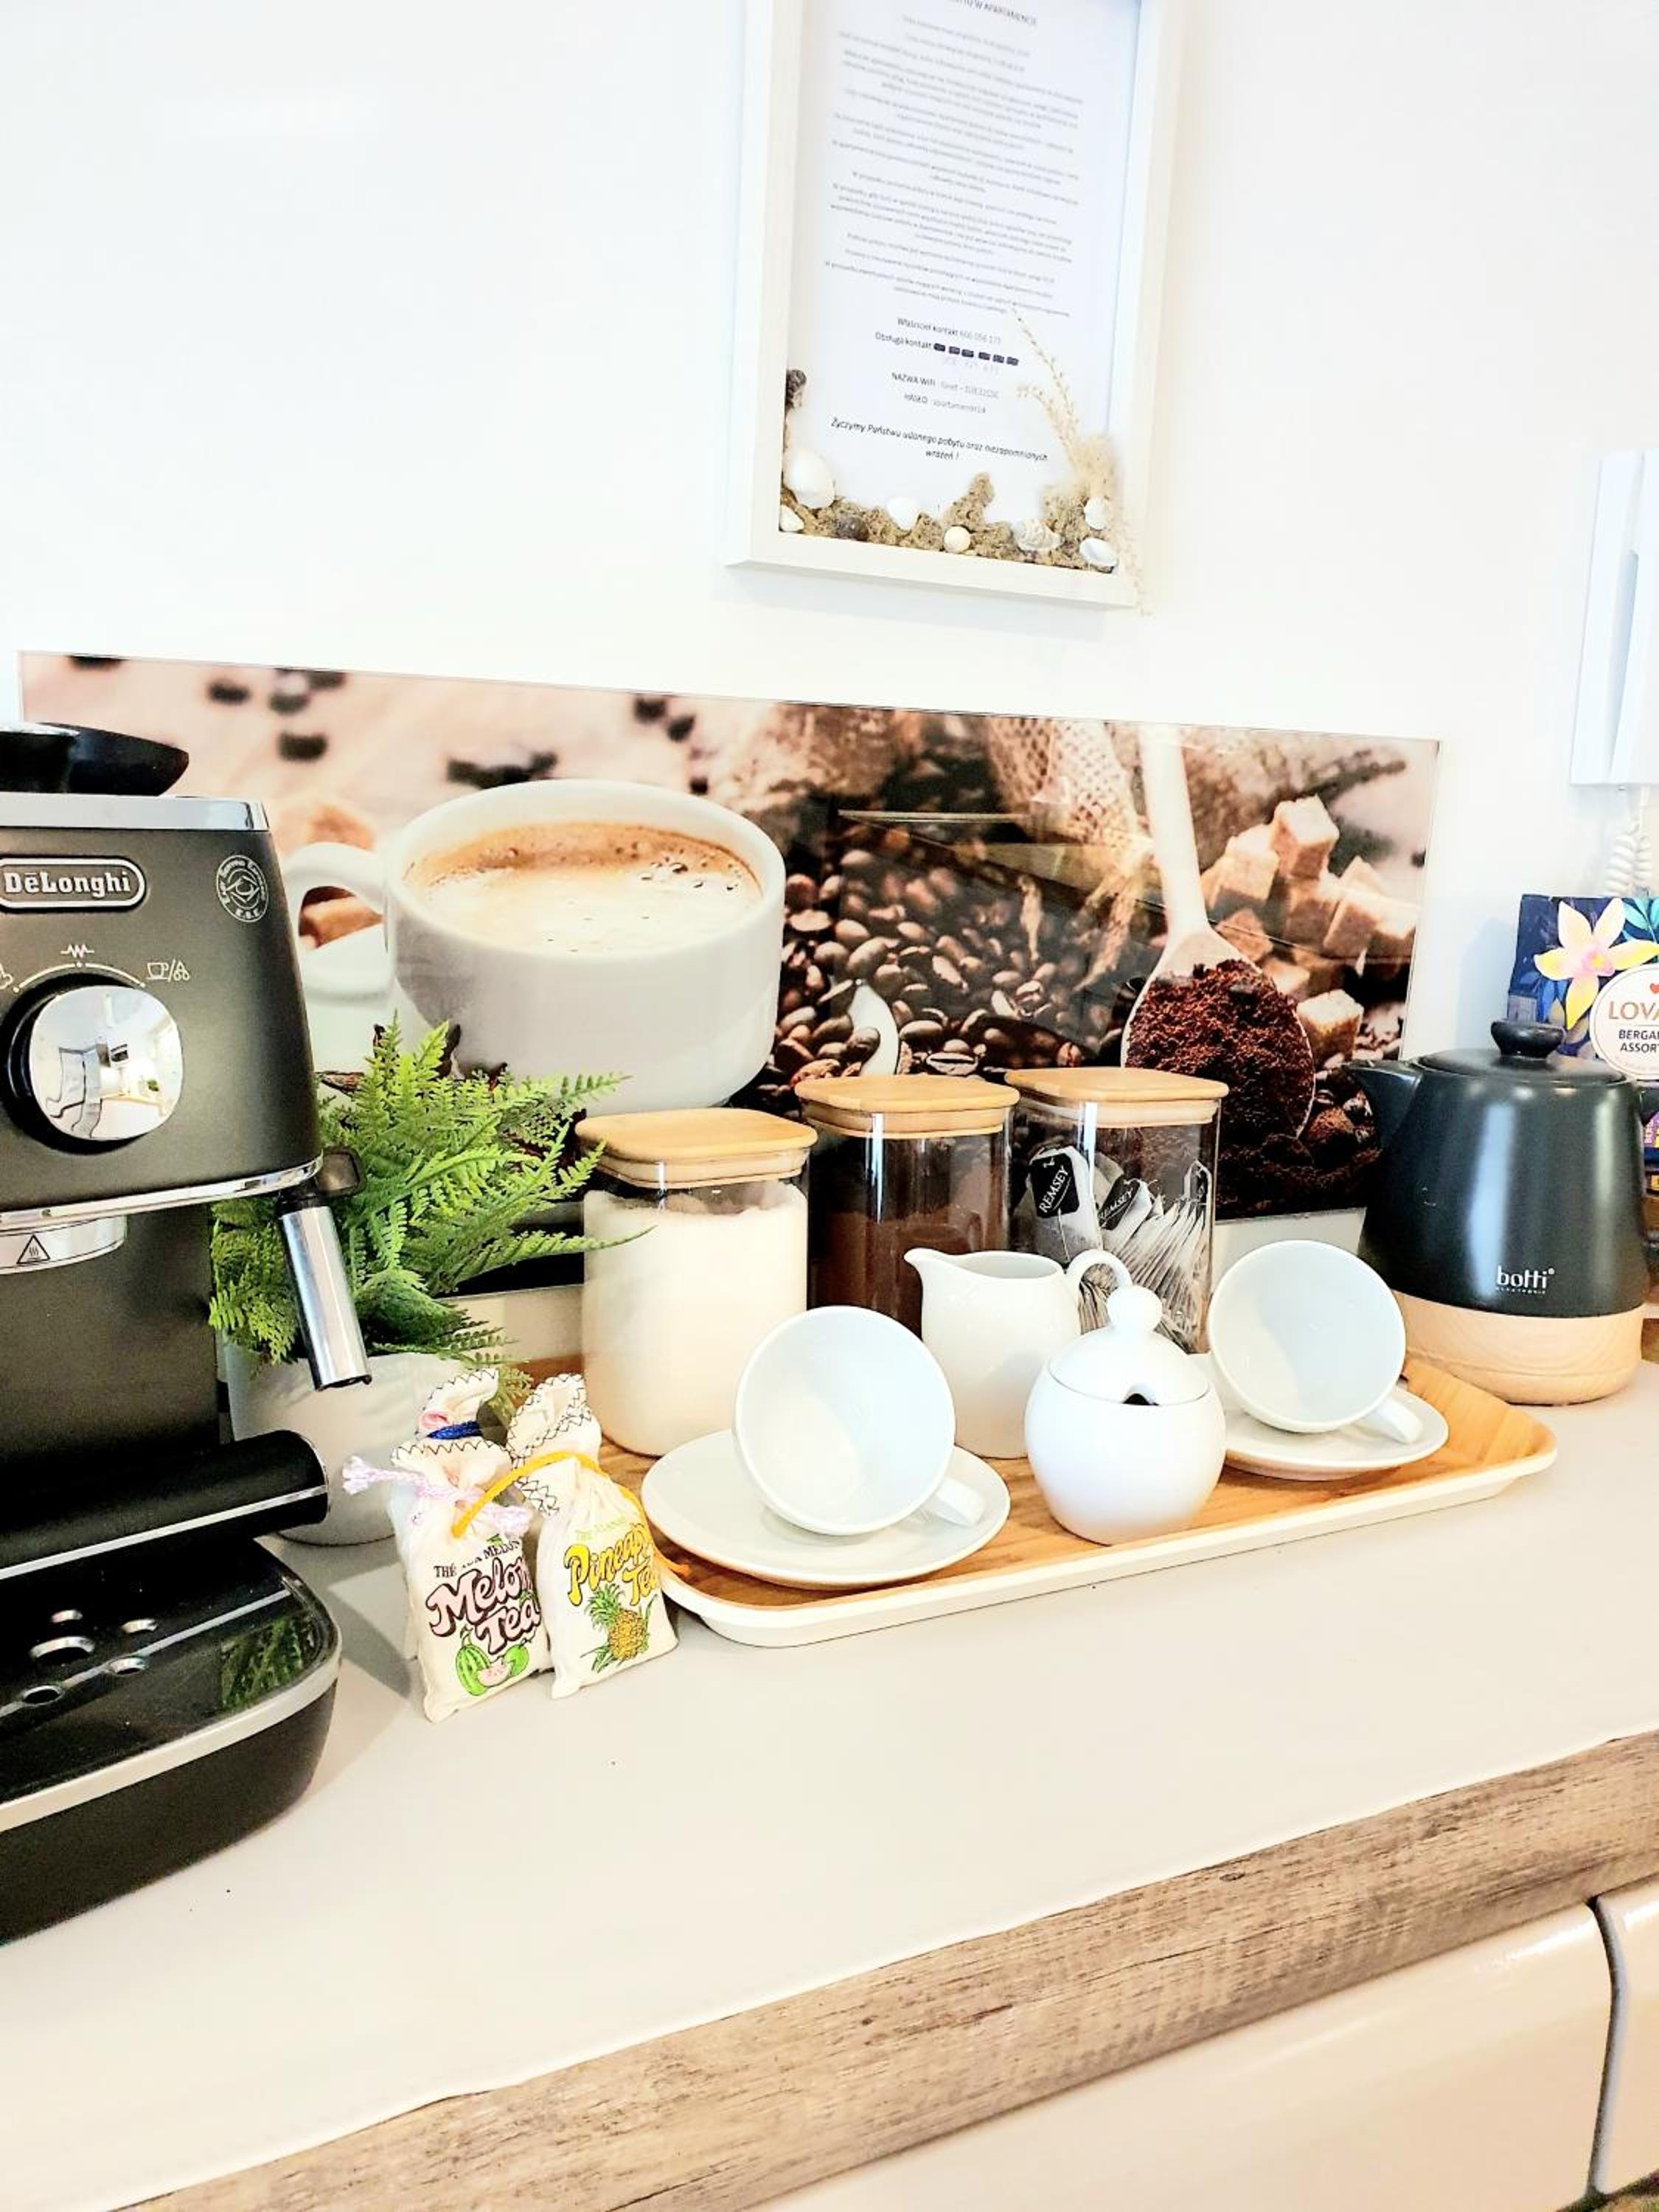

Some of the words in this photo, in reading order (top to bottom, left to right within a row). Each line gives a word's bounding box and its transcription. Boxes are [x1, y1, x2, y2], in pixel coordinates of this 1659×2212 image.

[905, 338, 932, 349] kontakt
[891, 372, 919, 384] NAZWA
[1618, 1029, 1659, 1041] BERGA
[1620, 1042, 1659, 1054] ASSOR
[1039, 1165, 1069, 1214] REMSEY
[425, 1557, 534, 1638] Melon
[475, 1596, 542, 1655] Tea
